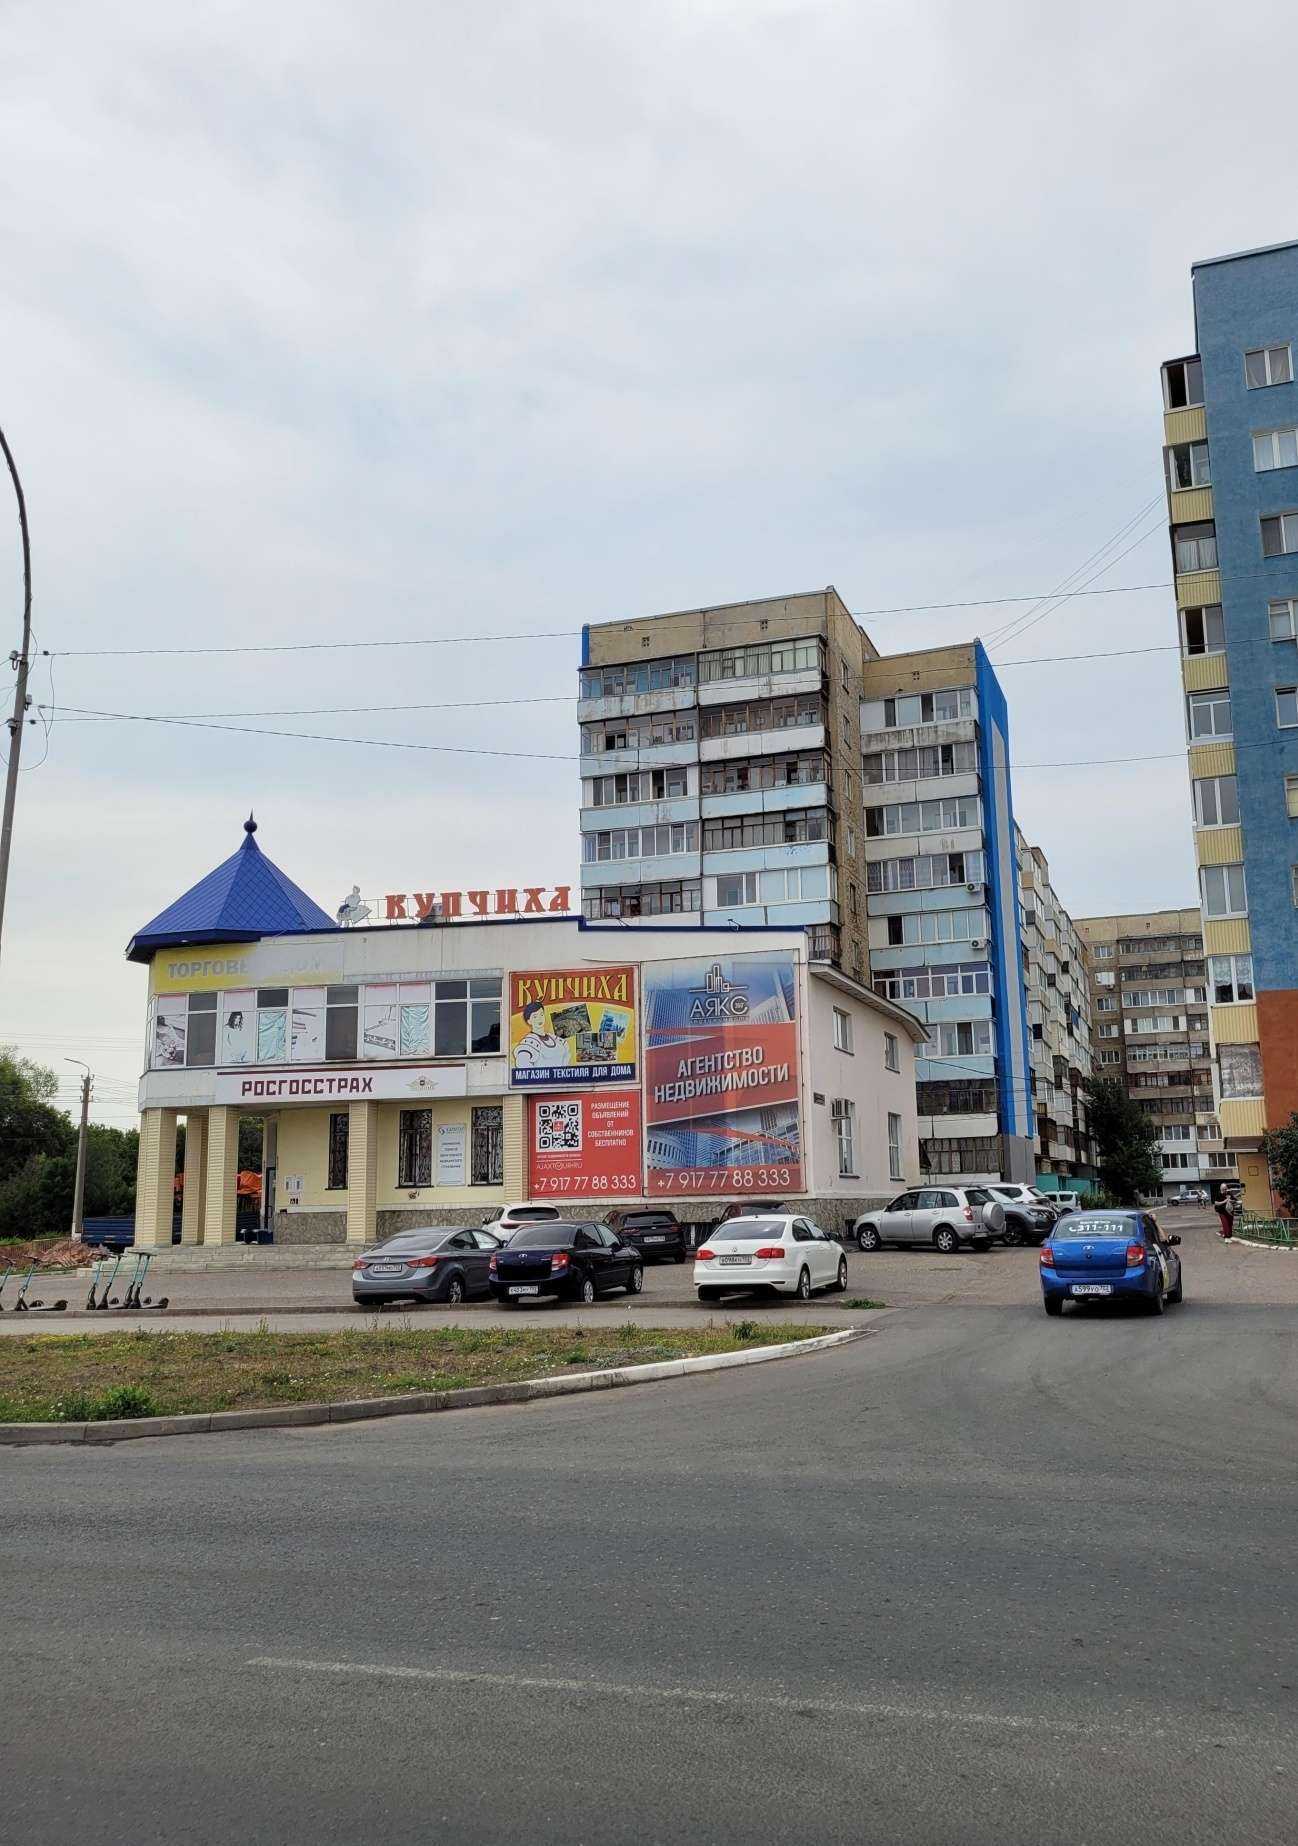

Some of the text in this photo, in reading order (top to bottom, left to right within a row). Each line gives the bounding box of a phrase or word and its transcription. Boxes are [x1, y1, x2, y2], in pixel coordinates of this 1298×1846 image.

[386, 886, 570, 919] КУПЧИХА
[517, 974, 629, 1007] КУПЧИХА
[690, 996, 748, 1018] АЯКС
[515, 1065, 632, 1080] МАГАЗИН ТЕКСТИЛЯ ДЛЯ ДОМА
[677, 1046, 763, 1078] АГЕНТСТВО
[242, 1077, 373, 1096] РОСГОССТРАХ
[654, 1063, 789, 1104] НЕДВИЖИМОСТИ
[591, 1101, 630, 1109] РАЗМЕЩЕНИЕ
[534, 1174, 636, 1191] +7 917 77 88 333
[657, 1168, 790, 1189] +7 917 77 88 333
